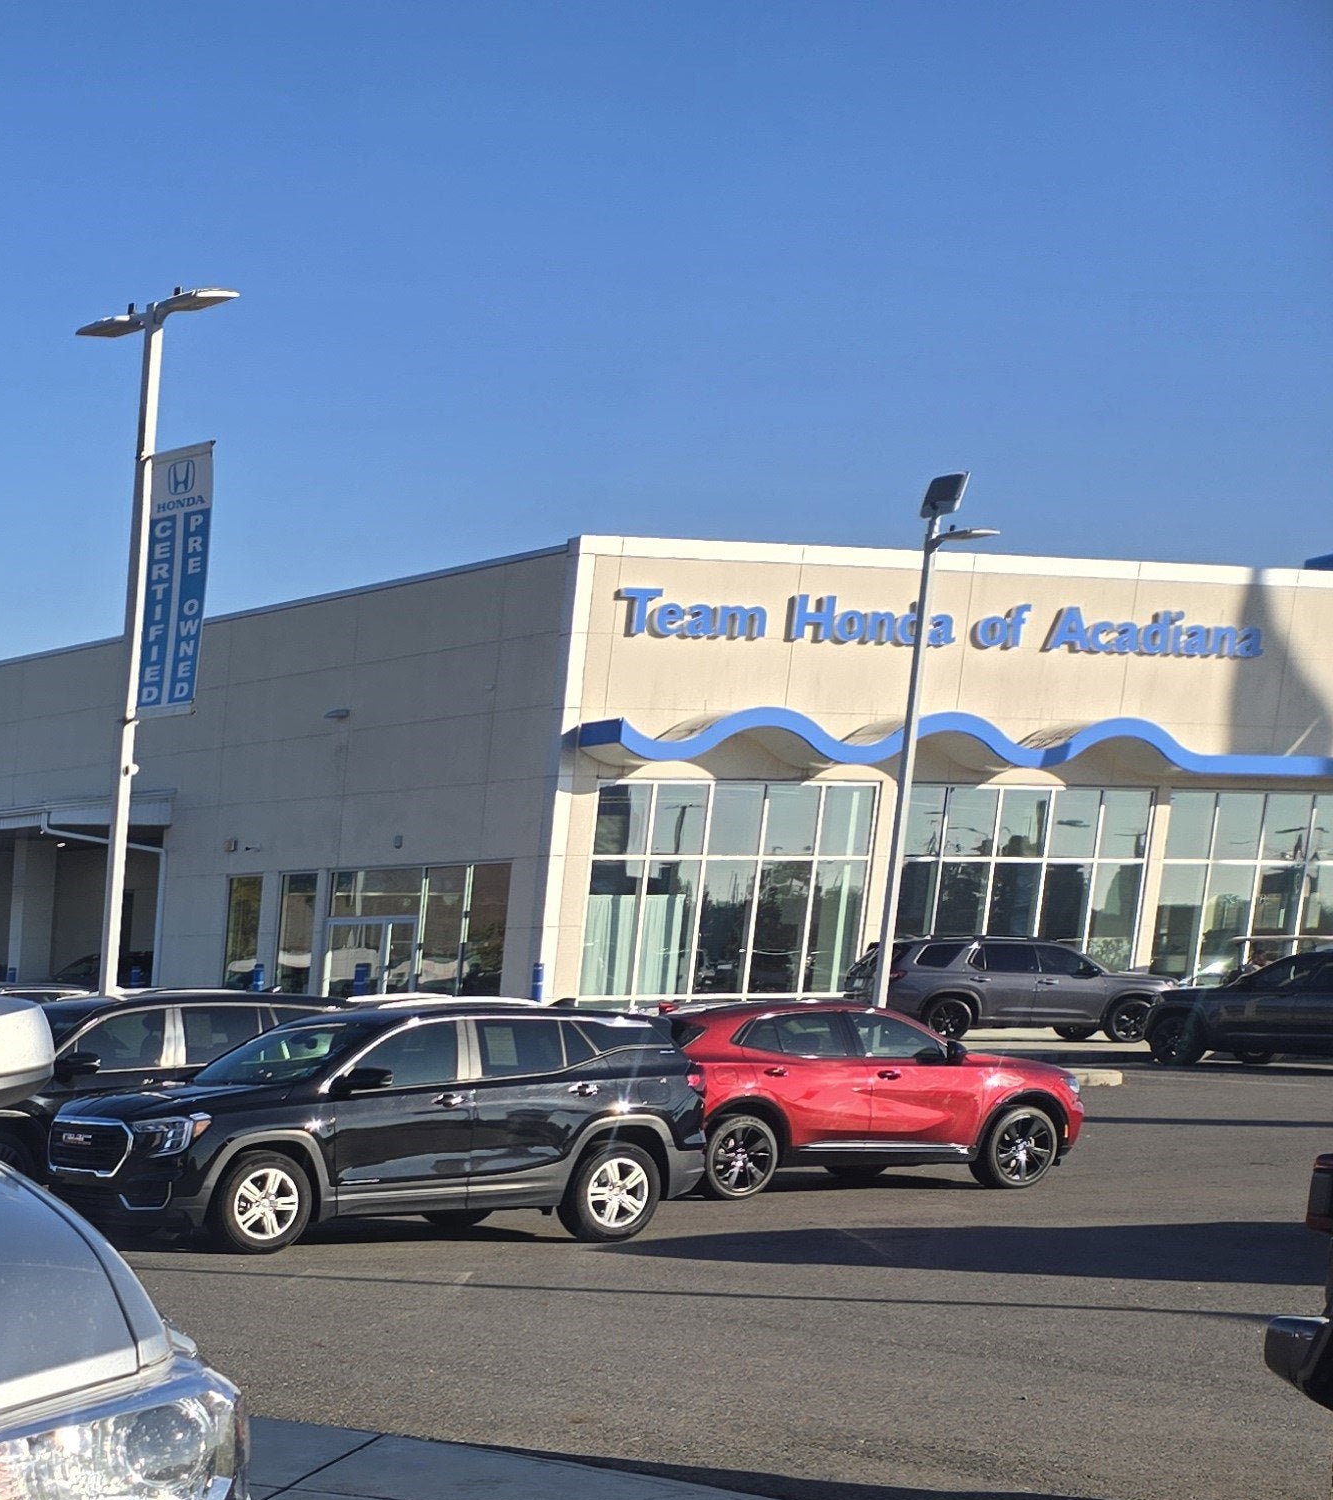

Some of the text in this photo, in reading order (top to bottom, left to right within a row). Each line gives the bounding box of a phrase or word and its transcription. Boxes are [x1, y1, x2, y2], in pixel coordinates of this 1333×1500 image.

[156, 495, 206, 514] HONDA
[141, 520, 174, 704] CERTIFIED
[173, 513, 205, 700] PRE OWNED
[617, 586, 767, 640] Team
[972, 603, 1033, 650] of
[1044, 606, 1265, 659] Acadiana
